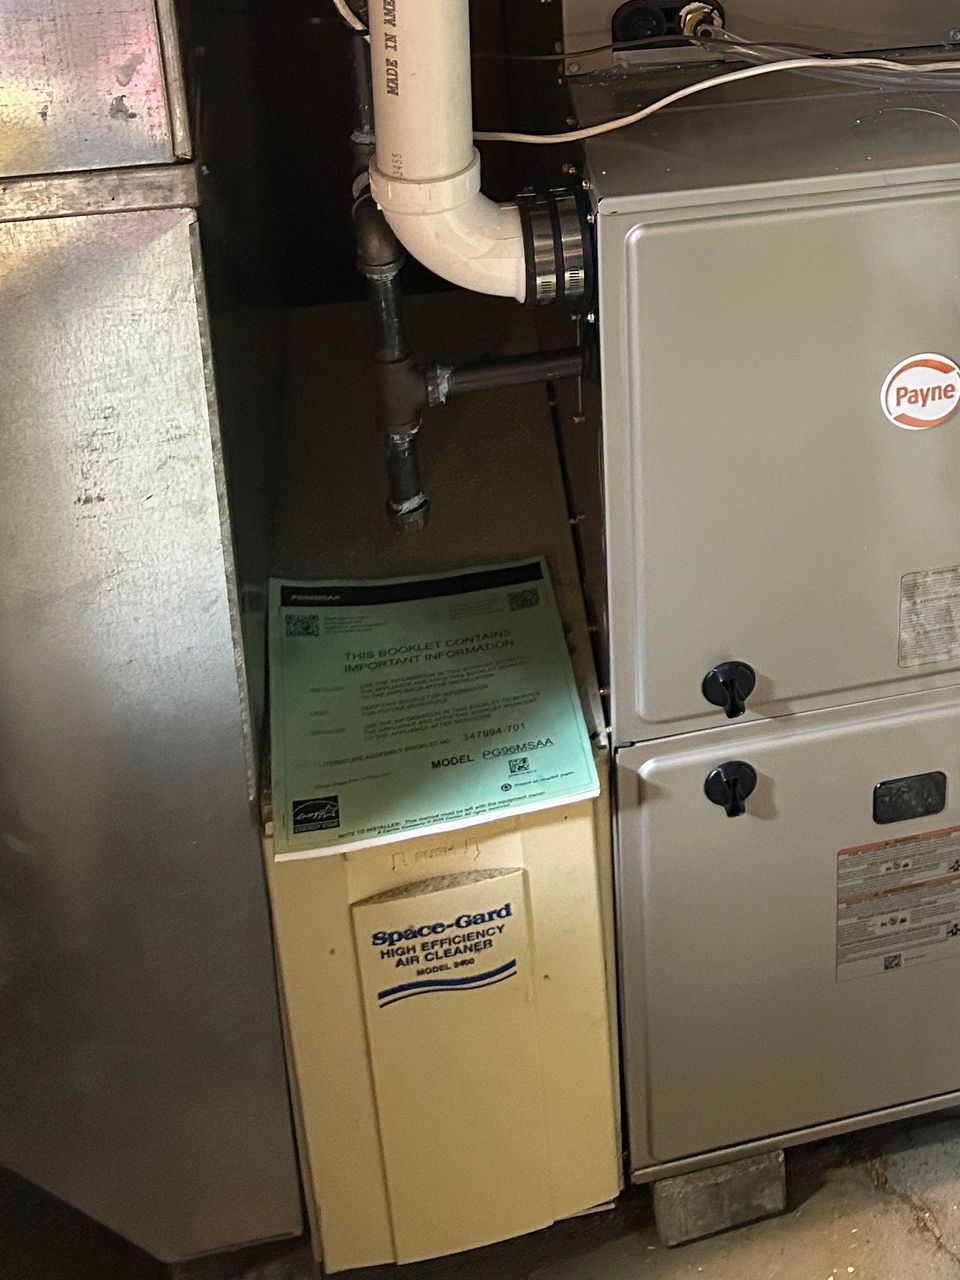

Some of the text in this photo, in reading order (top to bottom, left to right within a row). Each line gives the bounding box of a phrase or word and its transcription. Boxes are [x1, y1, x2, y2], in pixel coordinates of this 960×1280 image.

[384, 31, 398, 52] IN
[385, 58, 400, 97] MADE
[895, 382, 957, 411] Payne
[343, 639, 514, 673] IMPORTANT INFORMATION
[344, 628, 512, 661] THIS BOOKLET CONTAINS
[462, 722, 526, 742] 347994-701
[431, 753, 475, 770] MODEL
[482, 737, 554, 760] PG96MSAA
[371, 903, 512, 947] Space-Gard
[380, 924, 506, 960] HIGH EFFICIENCY
[395, 939, 493, 968] AIR CLEANER
[416, 964, 451, 976] MODEL
